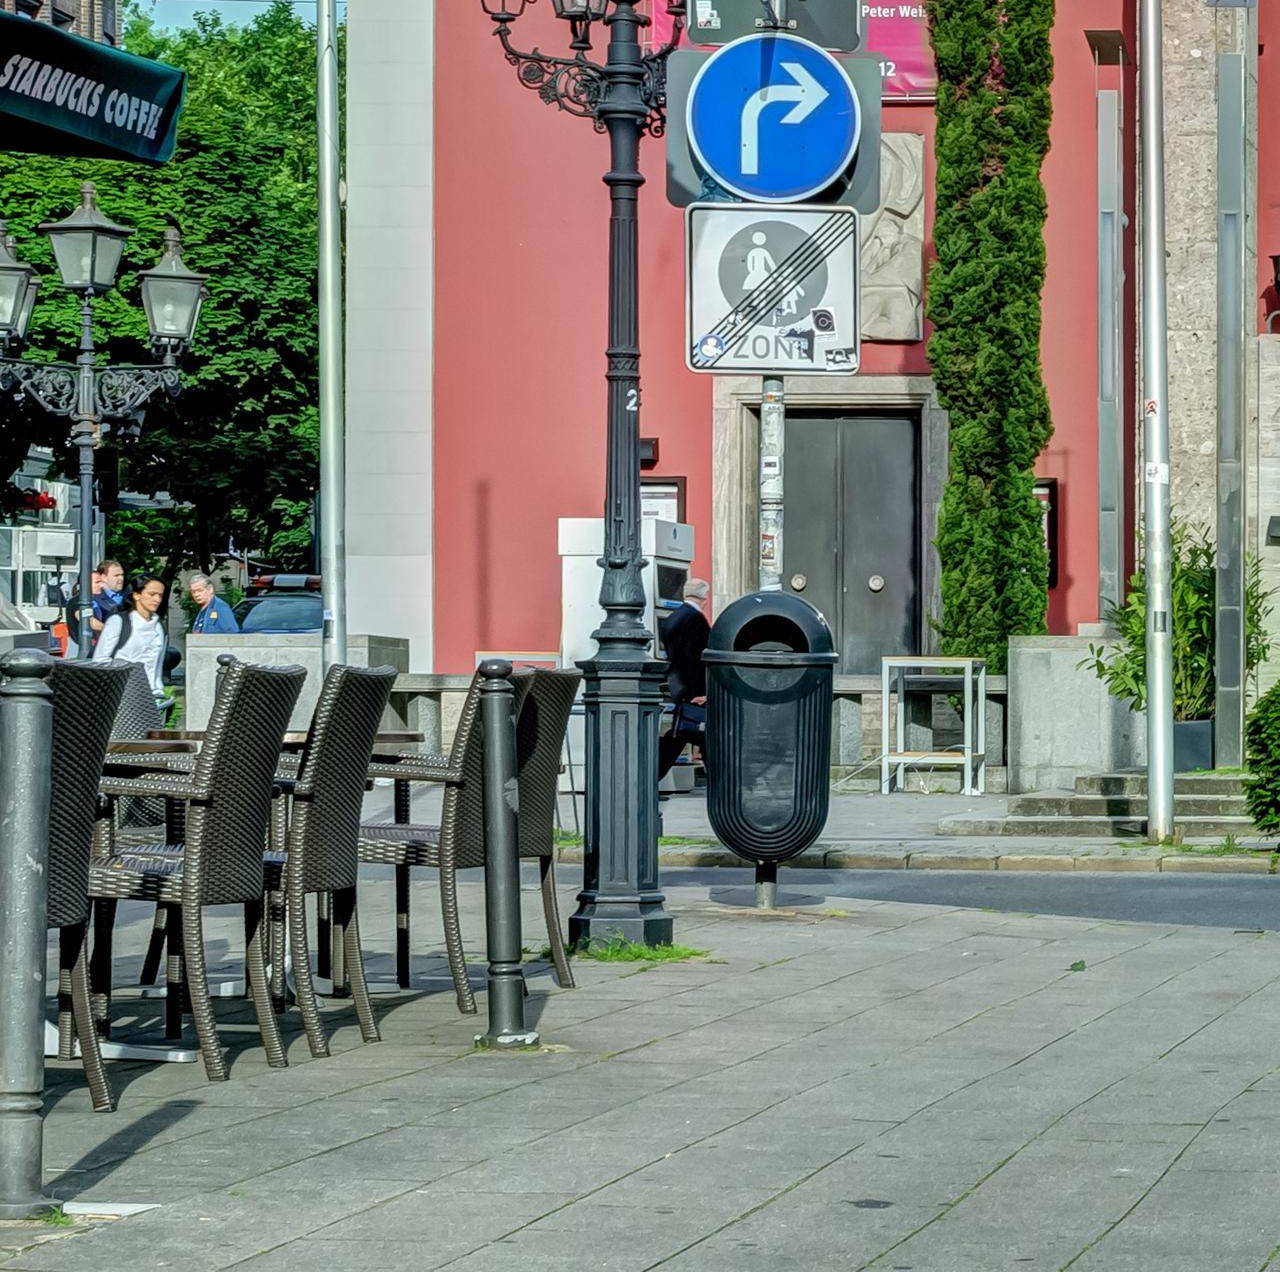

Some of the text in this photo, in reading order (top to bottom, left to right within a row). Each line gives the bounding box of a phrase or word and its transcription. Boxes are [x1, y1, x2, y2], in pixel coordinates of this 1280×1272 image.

[862, 5, 896, 18] Peter
[0, 54, 105, 118] STARBUCKS
[626, 389, 638, 411] 2
